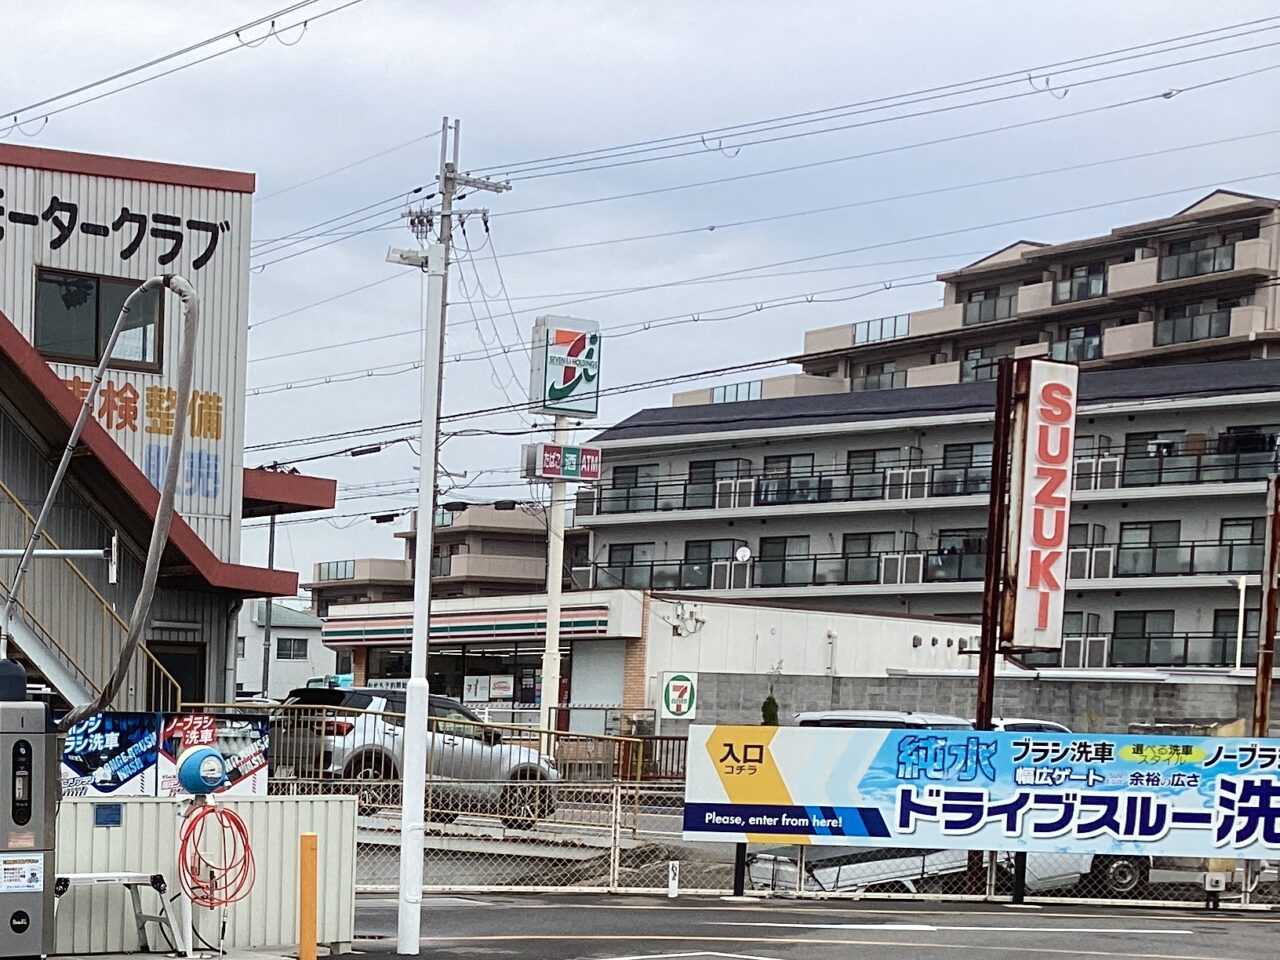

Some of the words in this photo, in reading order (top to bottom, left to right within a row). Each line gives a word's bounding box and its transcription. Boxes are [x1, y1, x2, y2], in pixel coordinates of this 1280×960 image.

[564, 453, 577, 471] 酒
[581, 454, 599, 473] ATM
[1028, 382, 1074, 630] SUZUKI
[166, 715, 214, 733] ノーブラシ
[184, 729, 214, 745] 洗車
[719, 742, 765, 764] 入口
[896, 735, 998, 782] 純水
[1012, 738, 1115, 763] ブラシ洗車
[1131, 743, 1194, 756] 選べる洗車
[1204, 744, 1280, 769] ノーブラ
[1137, 754, 1186, 766] スタイル
[724, 764, 758, 776] コチラ
[1014, 766, 1105, 787] 幅広ゲート
[1129, 771, 1200, 788] 余裕の広さ
[705, 812, 746, 827] Please,
[748, 814, 779, 827] enter
[781, 815, 809, 828] from
[812, 815, 843, 829] here!
[898, 778, 1280, 845] ドライブスルー洗
